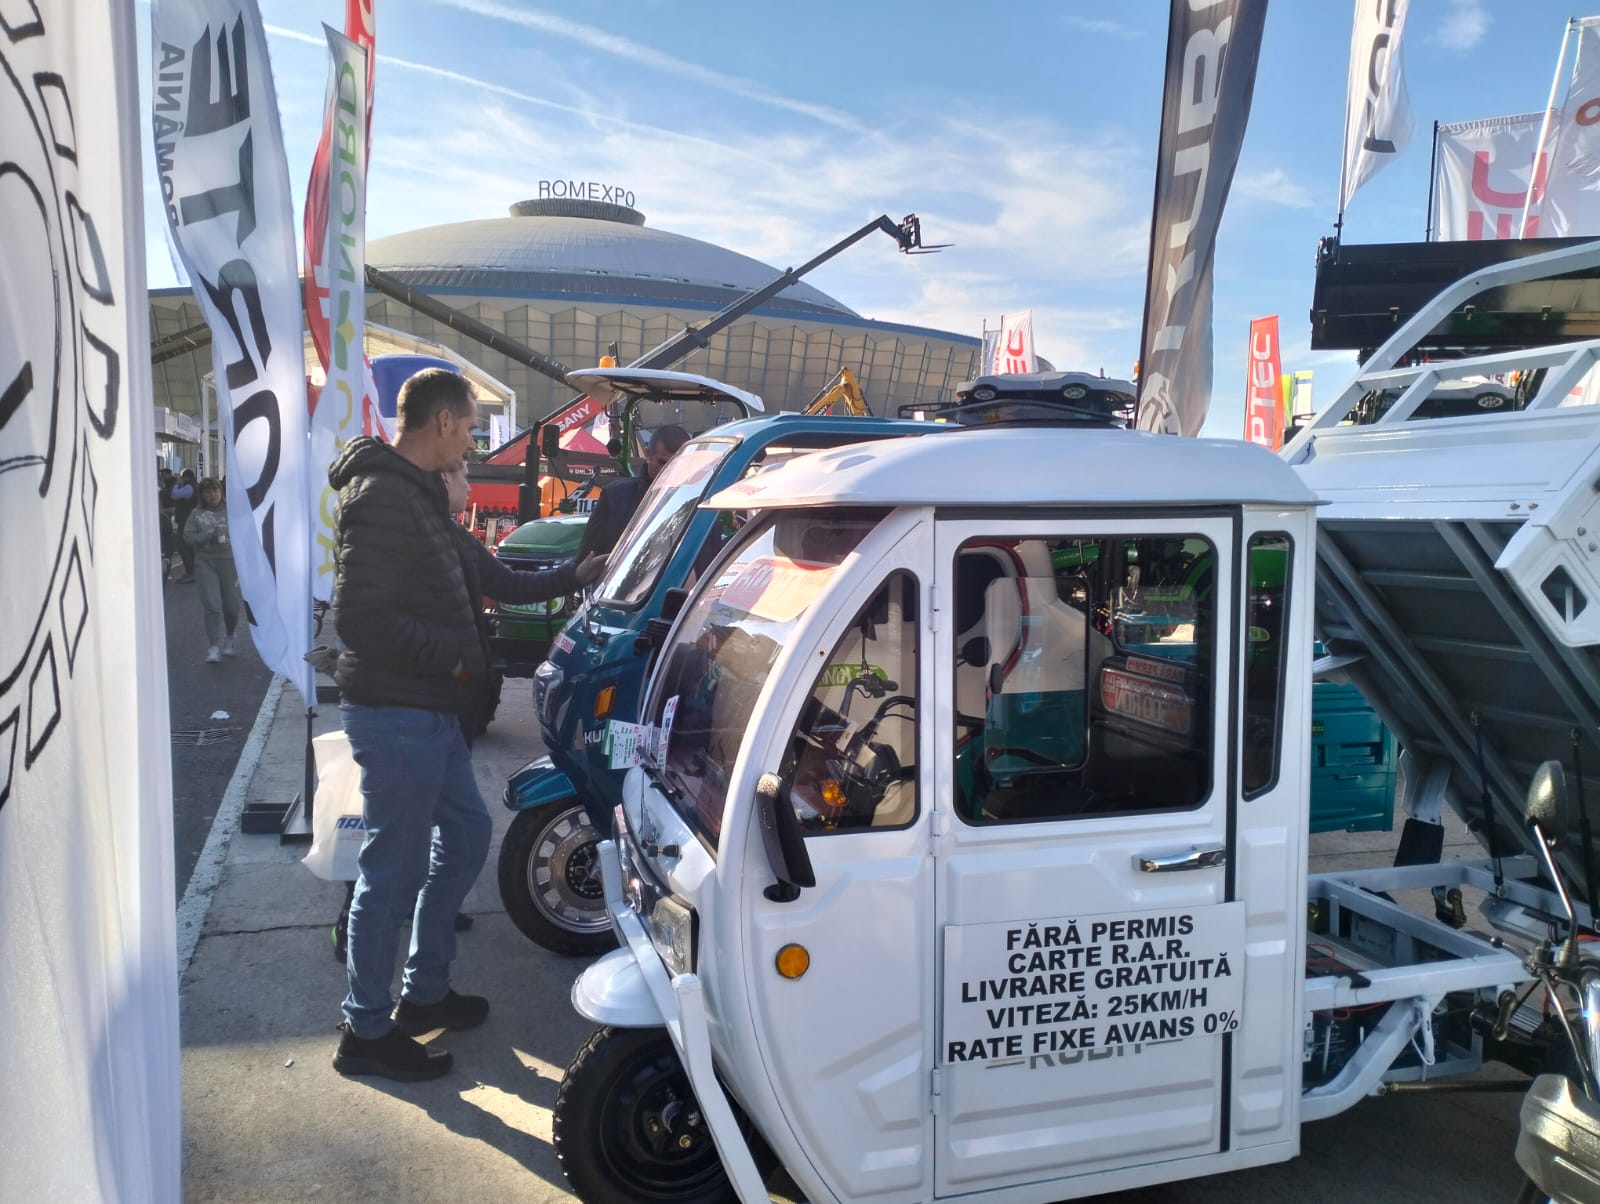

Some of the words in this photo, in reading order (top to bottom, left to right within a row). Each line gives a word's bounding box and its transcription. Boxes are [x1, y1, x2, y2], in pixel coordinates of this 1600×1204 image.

[538, 180, 635, 208] ROMEXPO
[559, 402, 591, 432] SANY
[1007, 919, 1081, 951] FĂRĂ
[1091, 914, 1194, 943] PERMIS
[1008, 945, 1102, 974] CARTE
[1111, 938, 1191, 965] R.A.R.
[961, 971, 1085, 1003] LIVRARE
[1094, 952, 1232, 989] GRATUITĂ
[986, 994, 1098, 1029] VITEZĂ:
[1107, 987, 1208, 1017] 25KM/H
[948, 1035, 1023, 1063] RATE
[1032, 1027, 1096, 1054] FIXE
[1103, 1016, 1195, 1045] AVANS
[1203, 1009, 1239, 1034] 0%
